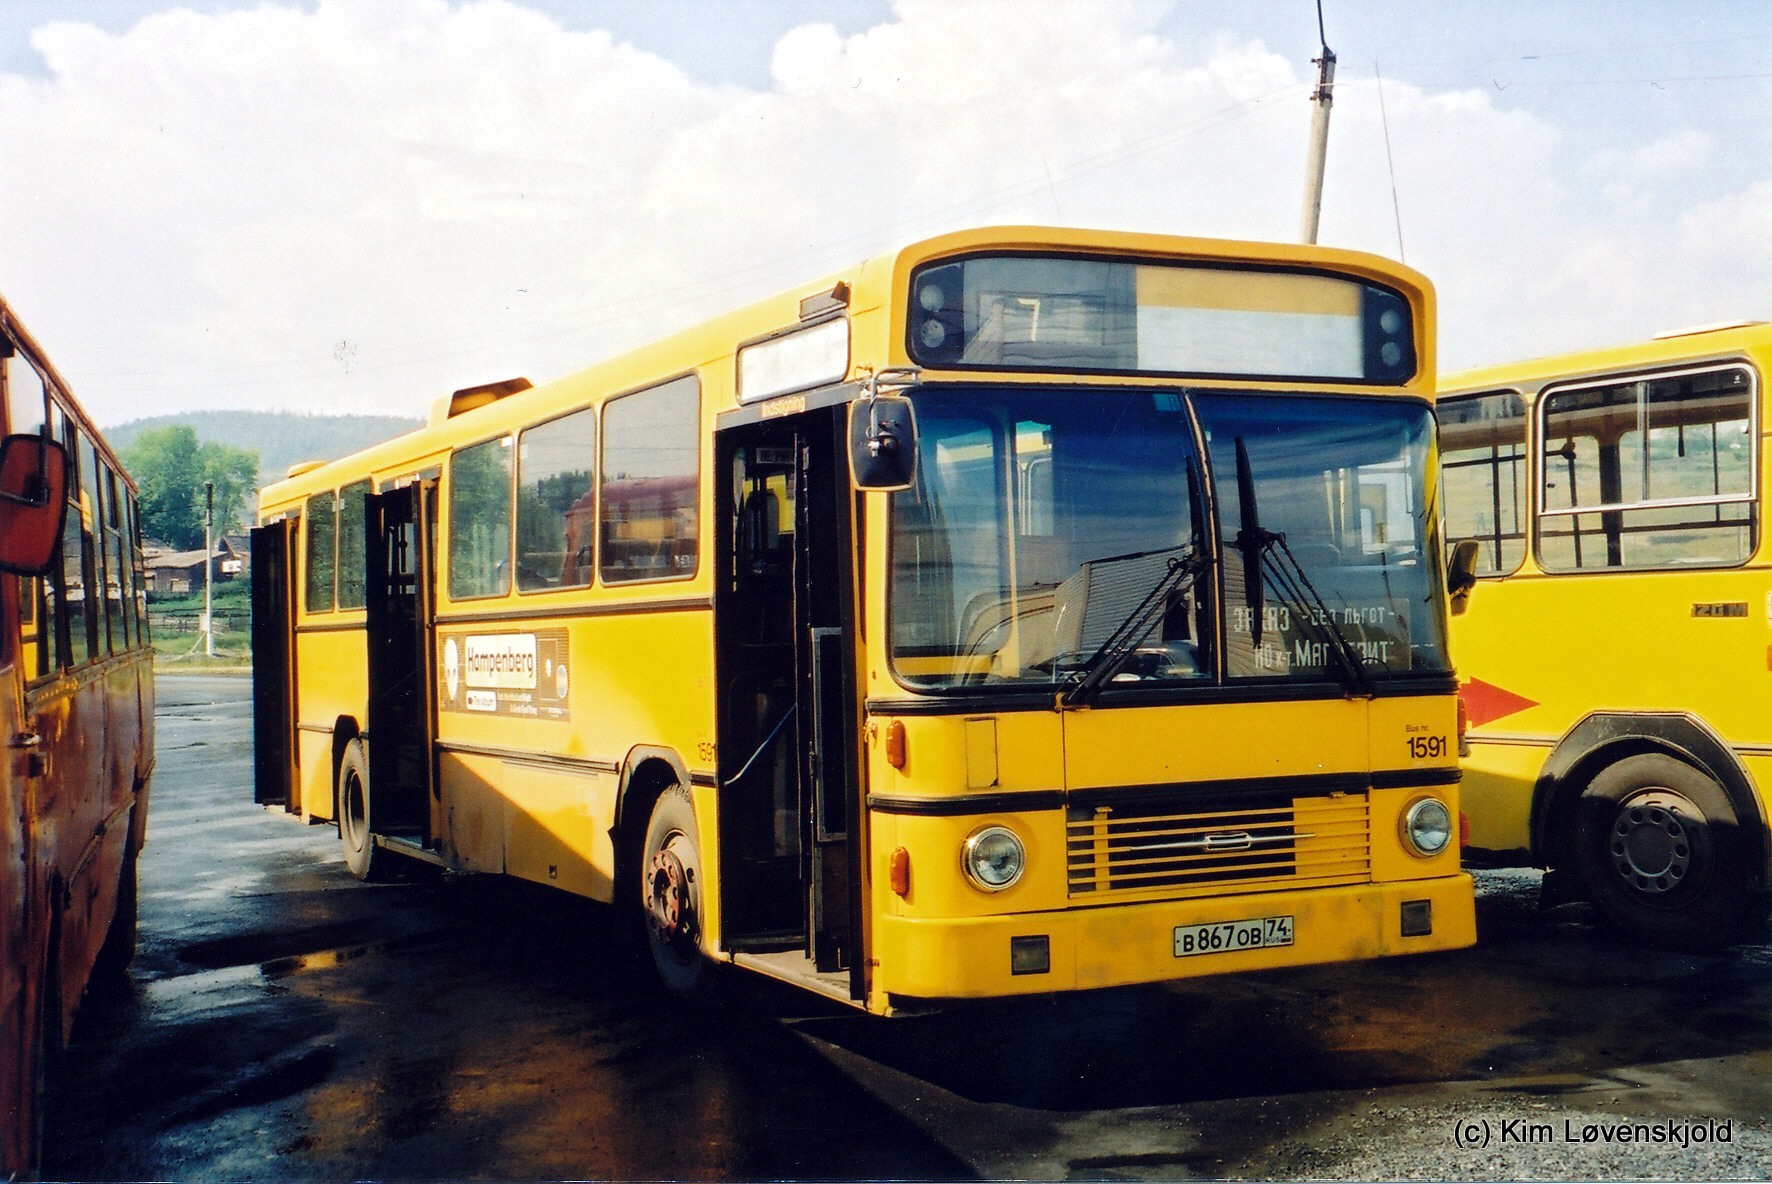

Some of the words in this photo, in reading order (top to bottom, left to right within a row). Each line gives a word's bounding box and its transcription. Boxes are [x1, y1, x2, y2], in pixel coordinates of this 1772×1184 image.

[1017, 297, 1040, 342] 7
[1406, 735, 1447, 758] 1591
[1266, 918, 1287, 937] 74
